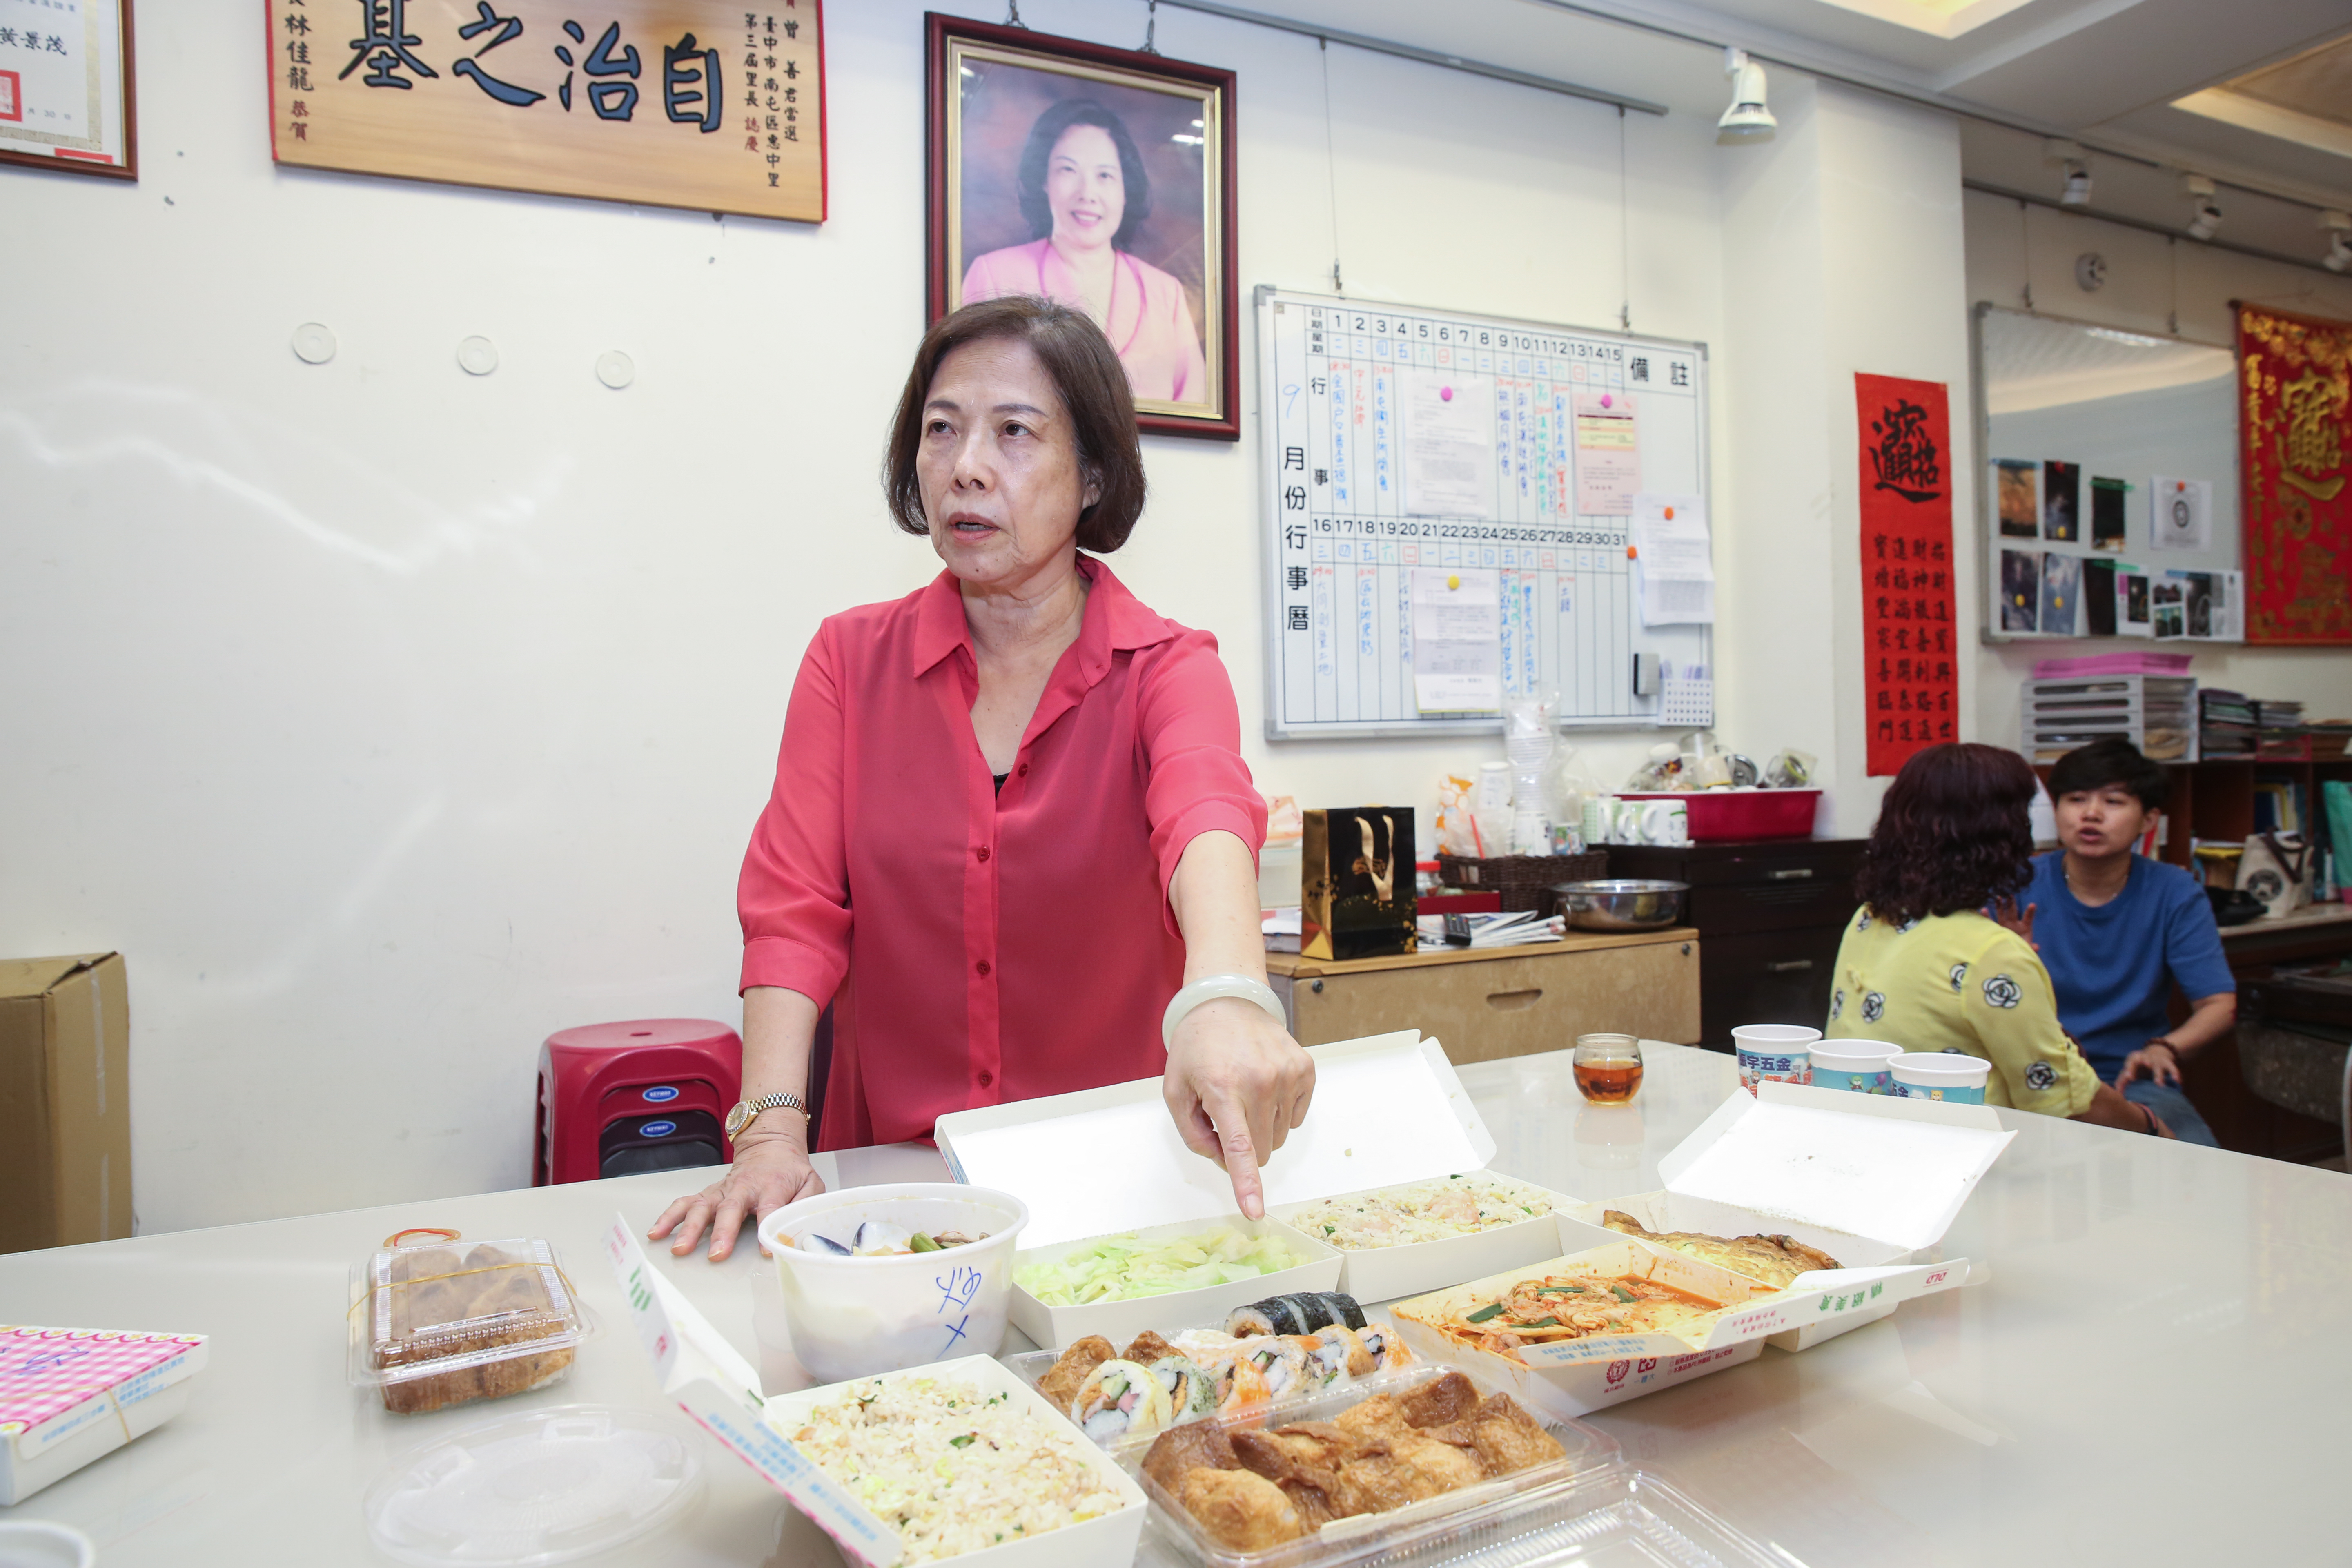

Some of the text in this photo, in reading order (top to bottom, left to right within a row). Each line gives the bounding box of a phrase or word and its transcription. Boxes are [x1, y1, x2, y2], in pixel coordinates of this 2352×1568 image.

[0, 27, 67, 56] 黃景茂
[285, 0, 314, 92] 林佳龍
[1335, 315, 1341, 327] 1
[1355, 317, 1365, 330] 2
[1376, 320, 1386, 333] 3
[1397, 323, 1407, 334] 4
[1419, 325, 1428, 337] 5
[1439, 327, 1449, 340] 6
[1459, 330, 1468, 342] 7
[1480, 332, 1489, 345] 8
[1499, 334, 1508, 347] 9
[1515, 336, 1531, 350] 10
[1535, 339, 1548, 352] 11
[1553, 341, 1567, 354] 12
[1571, 344, 1586, 356] 13
[1589, 346, 1604, 358] 14
[1606, 348, 1622, 361] 15
[1285, 446, 1309, 630] 月份行事曆
[1313, 519, 1626, 546] 16 17 18 19 20 21 22 23 24 25 26 27 28 29 30 31
